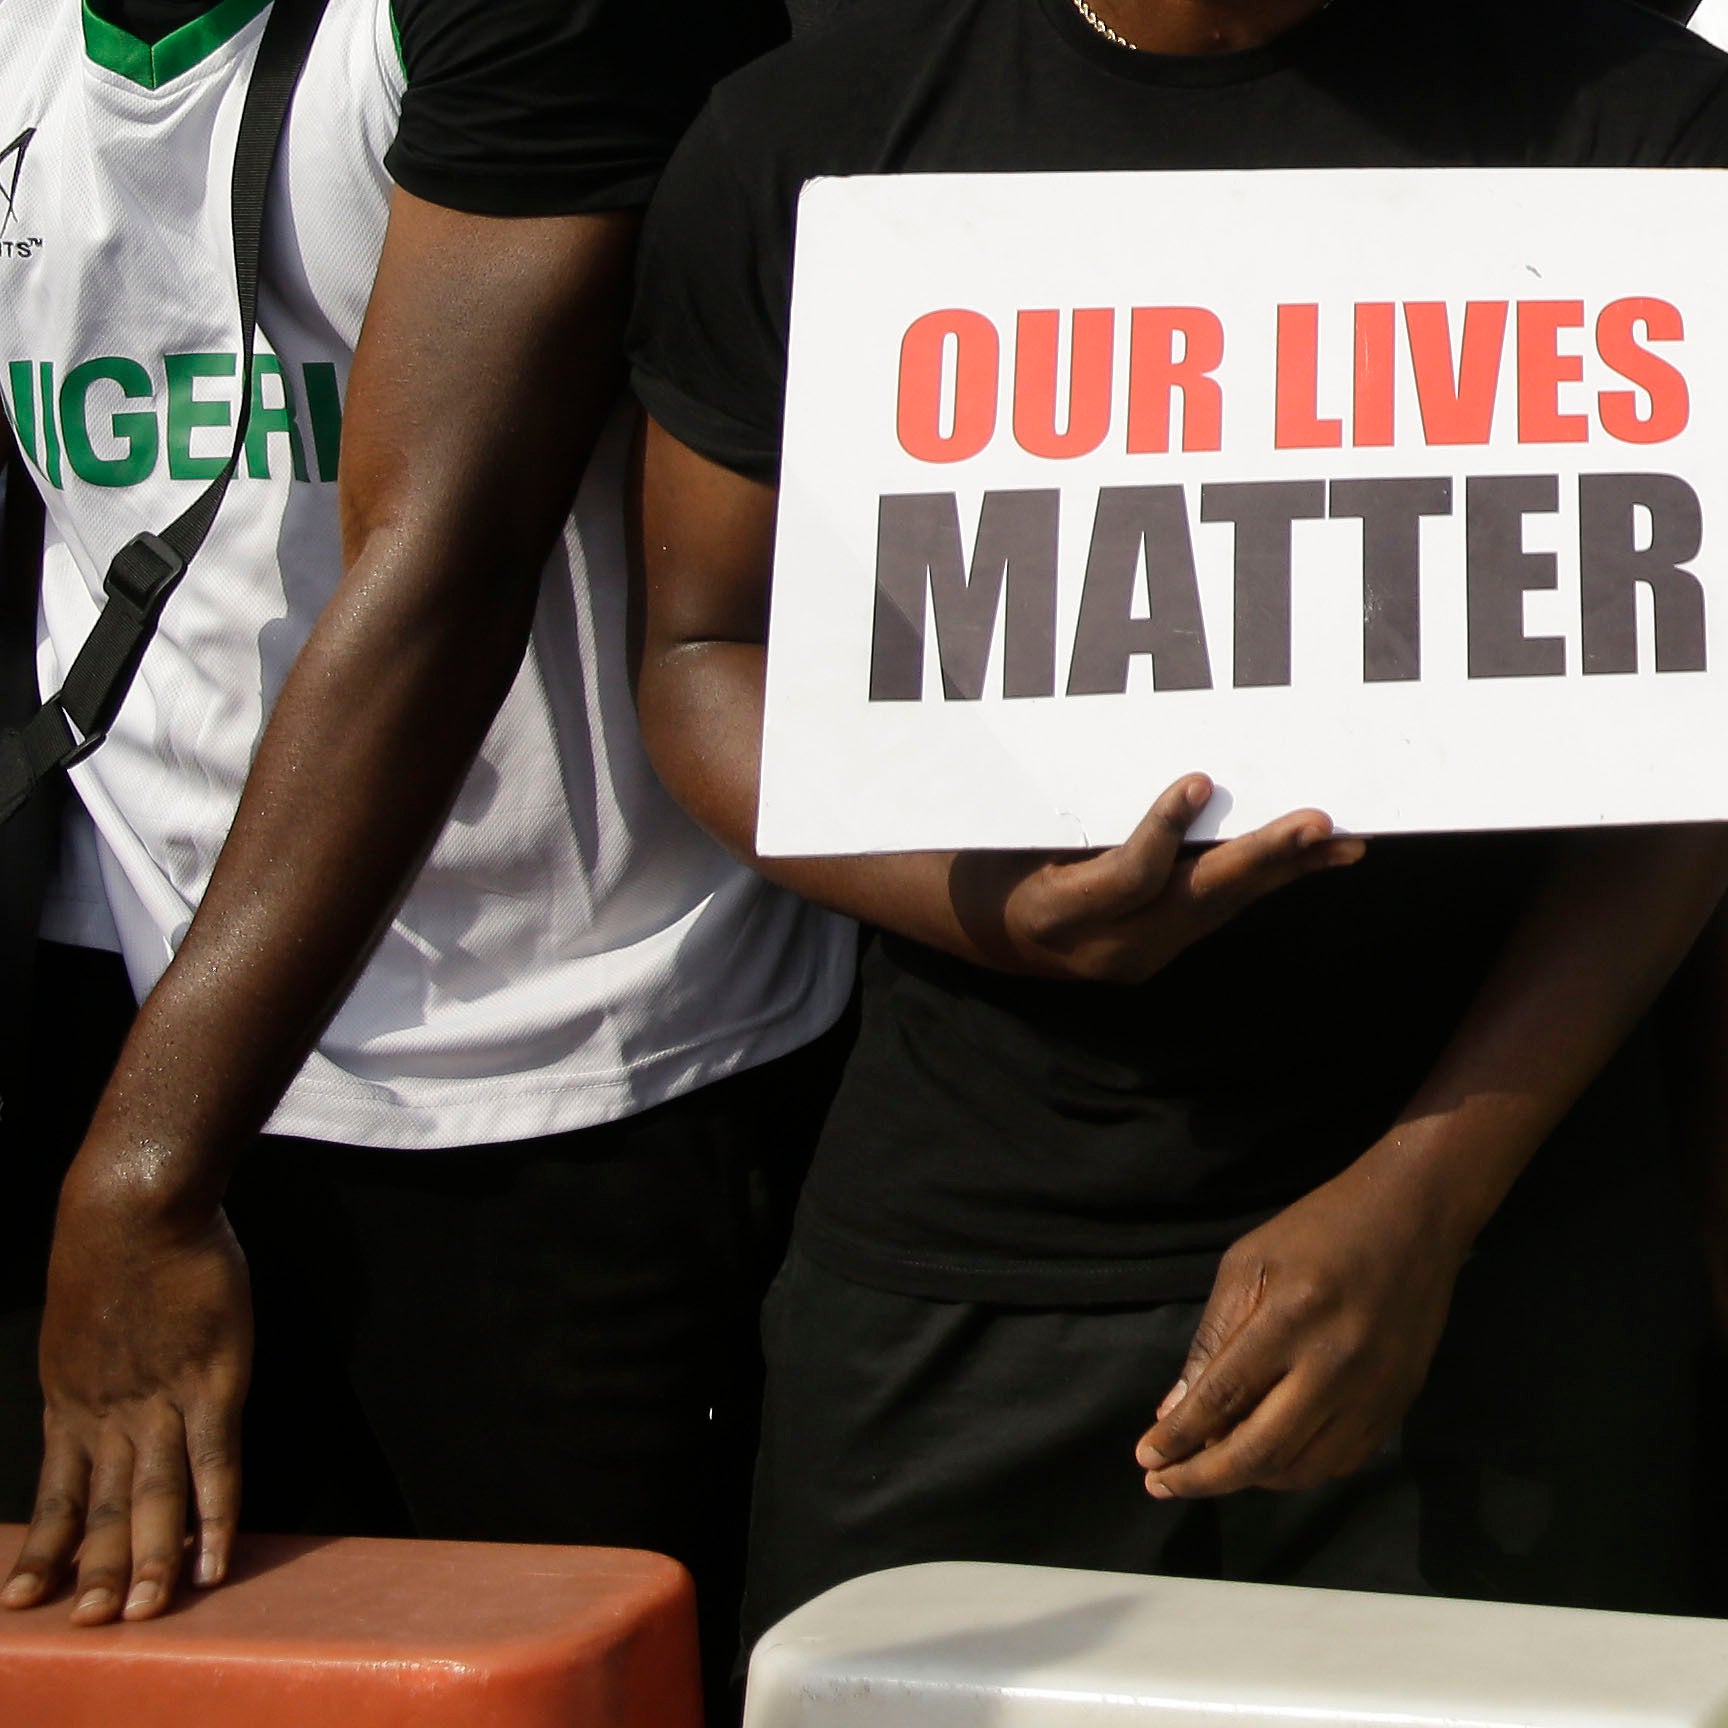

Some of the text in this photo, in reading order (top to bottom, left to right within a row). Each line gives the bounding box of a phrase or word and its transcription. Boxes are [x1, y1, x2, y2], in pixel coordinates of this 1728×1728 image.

[896, 296, 1690, 464] OUR LIVES
[867, 471, 1708, 703] MATTER
